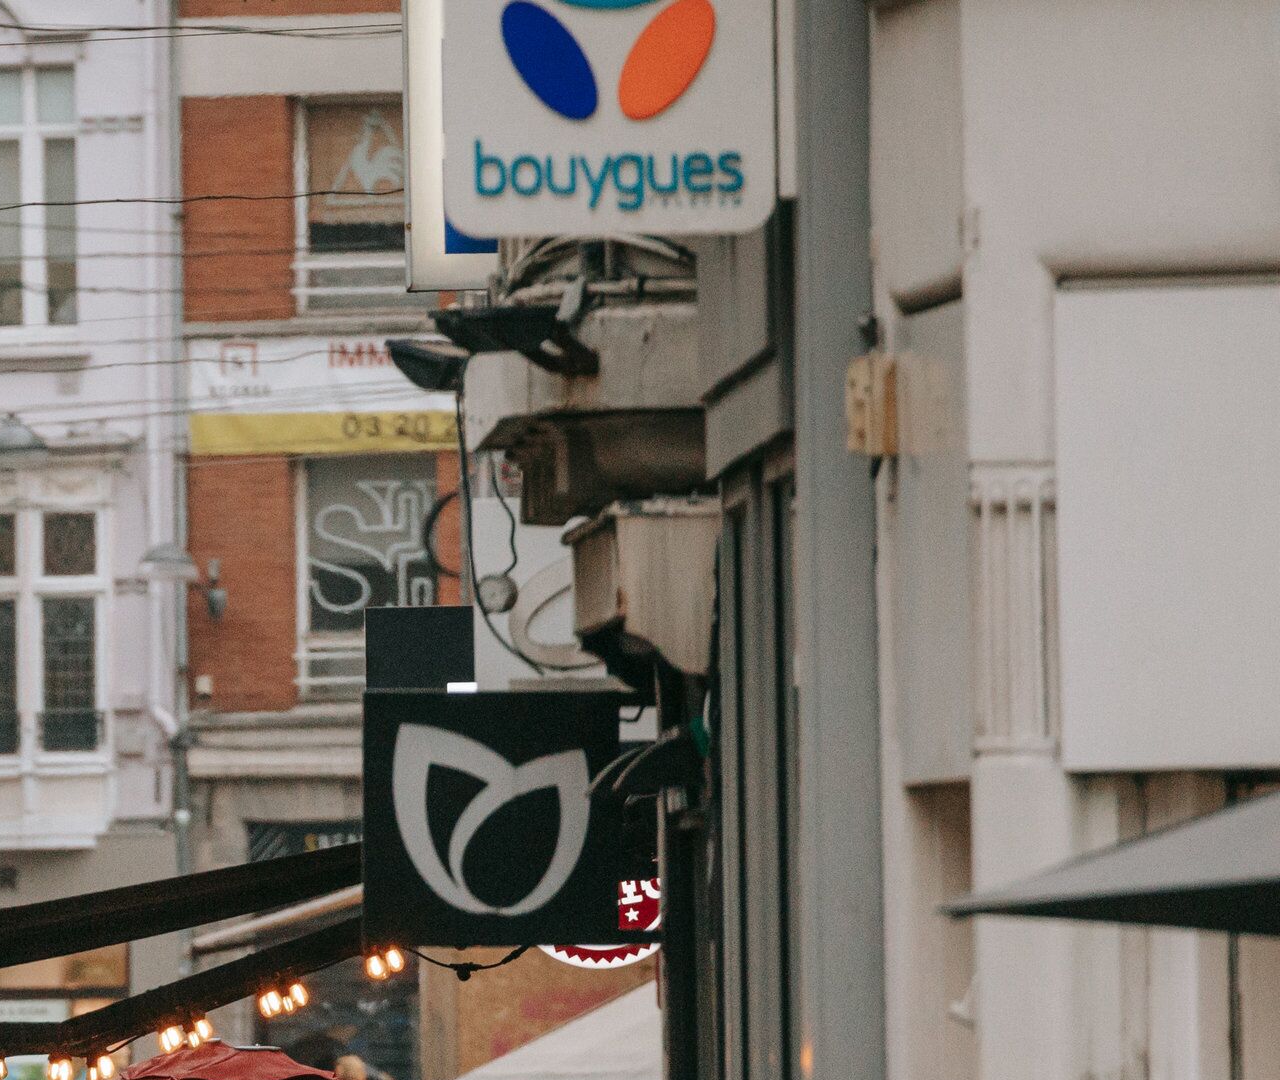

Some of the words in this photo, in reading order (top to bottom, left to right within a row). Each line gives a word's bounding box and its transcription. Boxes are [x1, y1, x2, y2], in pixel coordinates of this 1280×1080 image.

[473, 138, 745, 212] bouygues
[328, 341, 392, 368] IMM
[341, 414, 381, 438] 03
